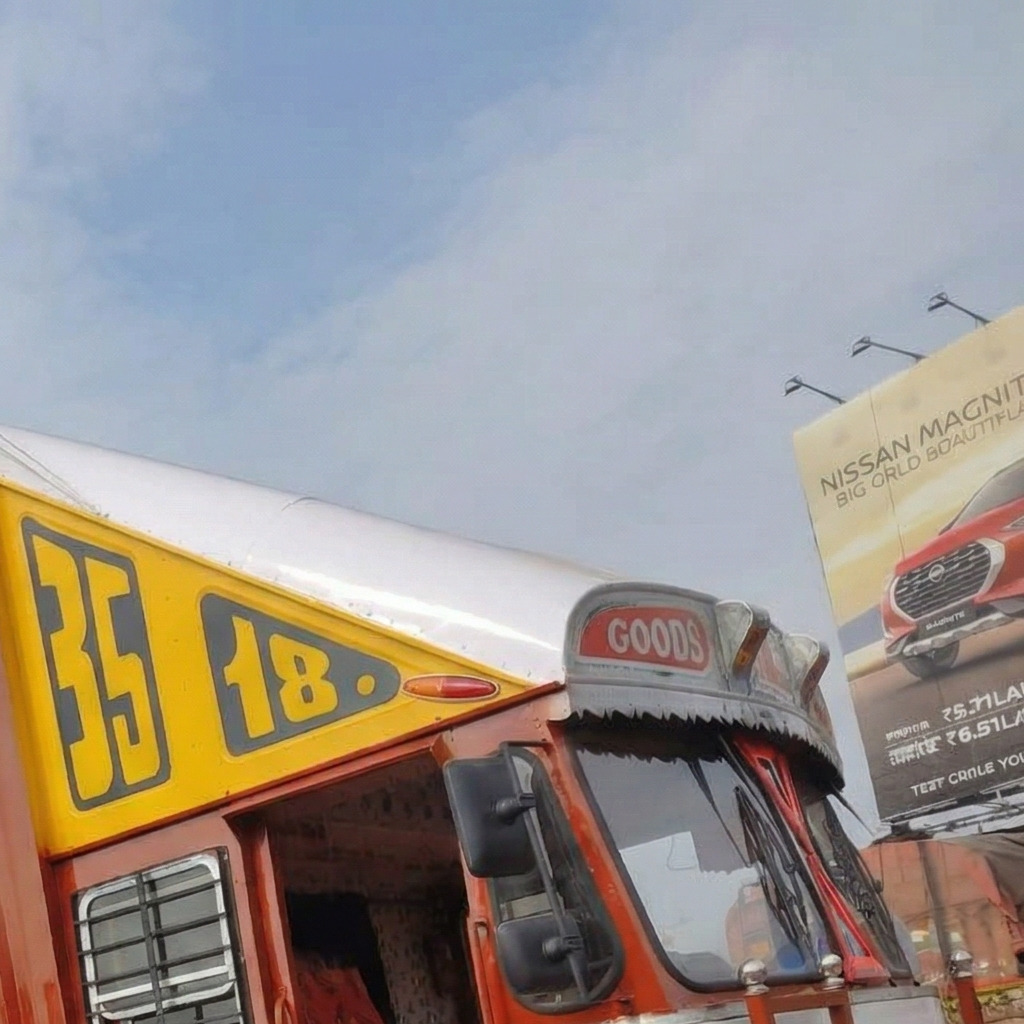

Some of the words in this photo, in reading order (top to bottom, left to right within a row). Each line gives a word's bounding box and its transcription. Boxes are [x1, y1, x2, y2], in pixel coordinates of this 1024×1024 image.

[820, 434, 911, 497] NISSAN
[835, 481, 867, 509] BIG
[32, 534, 160, 799] 35
[607, 618, 705, 663] GOODS
